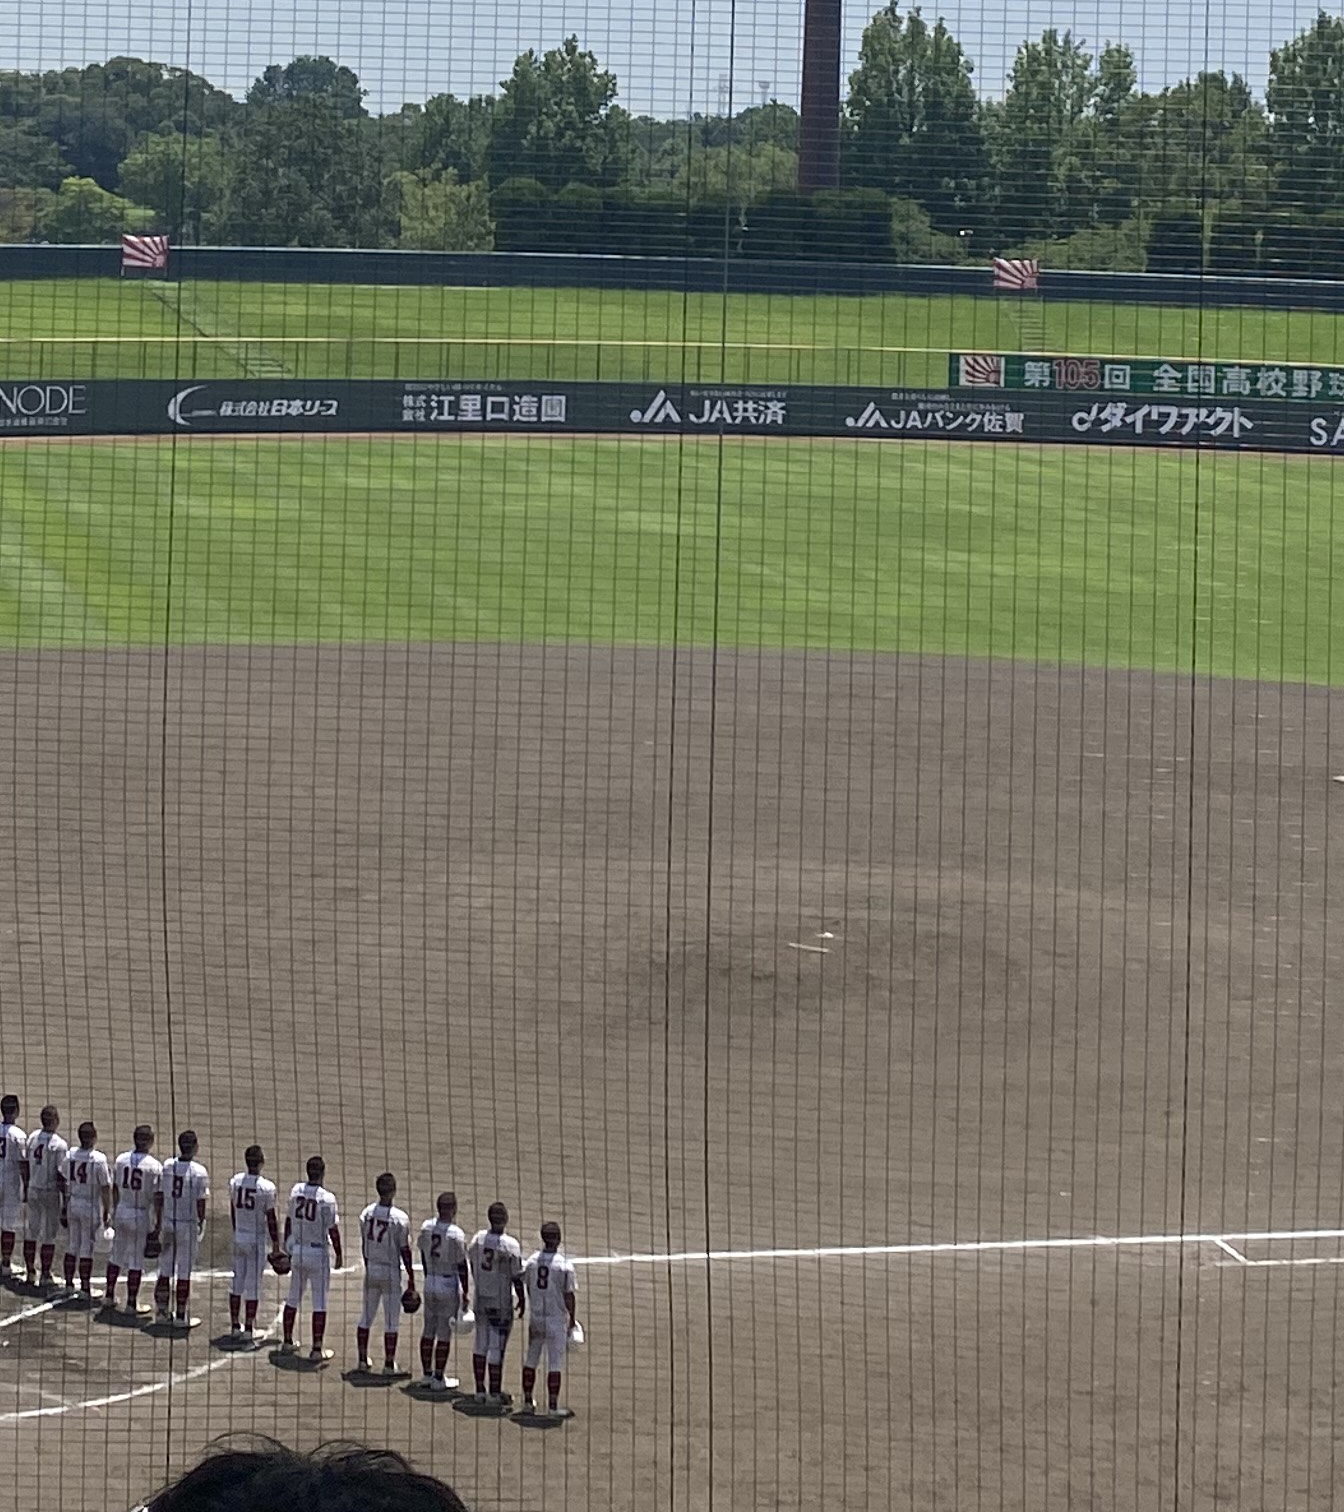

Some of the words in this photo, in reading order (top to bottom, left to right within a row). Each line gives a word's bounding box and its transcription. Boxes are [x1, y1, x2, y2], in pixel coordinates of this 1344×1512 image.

[1023, 359, 1131, 390] 第105回
[688, 399, 787, 425] JA共済
[891, 411, 1025, 434] JAバンク佐賀
[34, 1143, 44, 1166] 4
[69, 1161, 87, 1184] 14
[122, 1166, 143, 1190] 16
[236, 1186, 256, 1210] 15
[295, 1196, 316, 1221] 20
[367, 1218, 389, 1243] 17
[431, 1234, 441, 1257] 2
[481, 1247, 494, 1272] 3
[537, 1265, 549, 1289] 8
